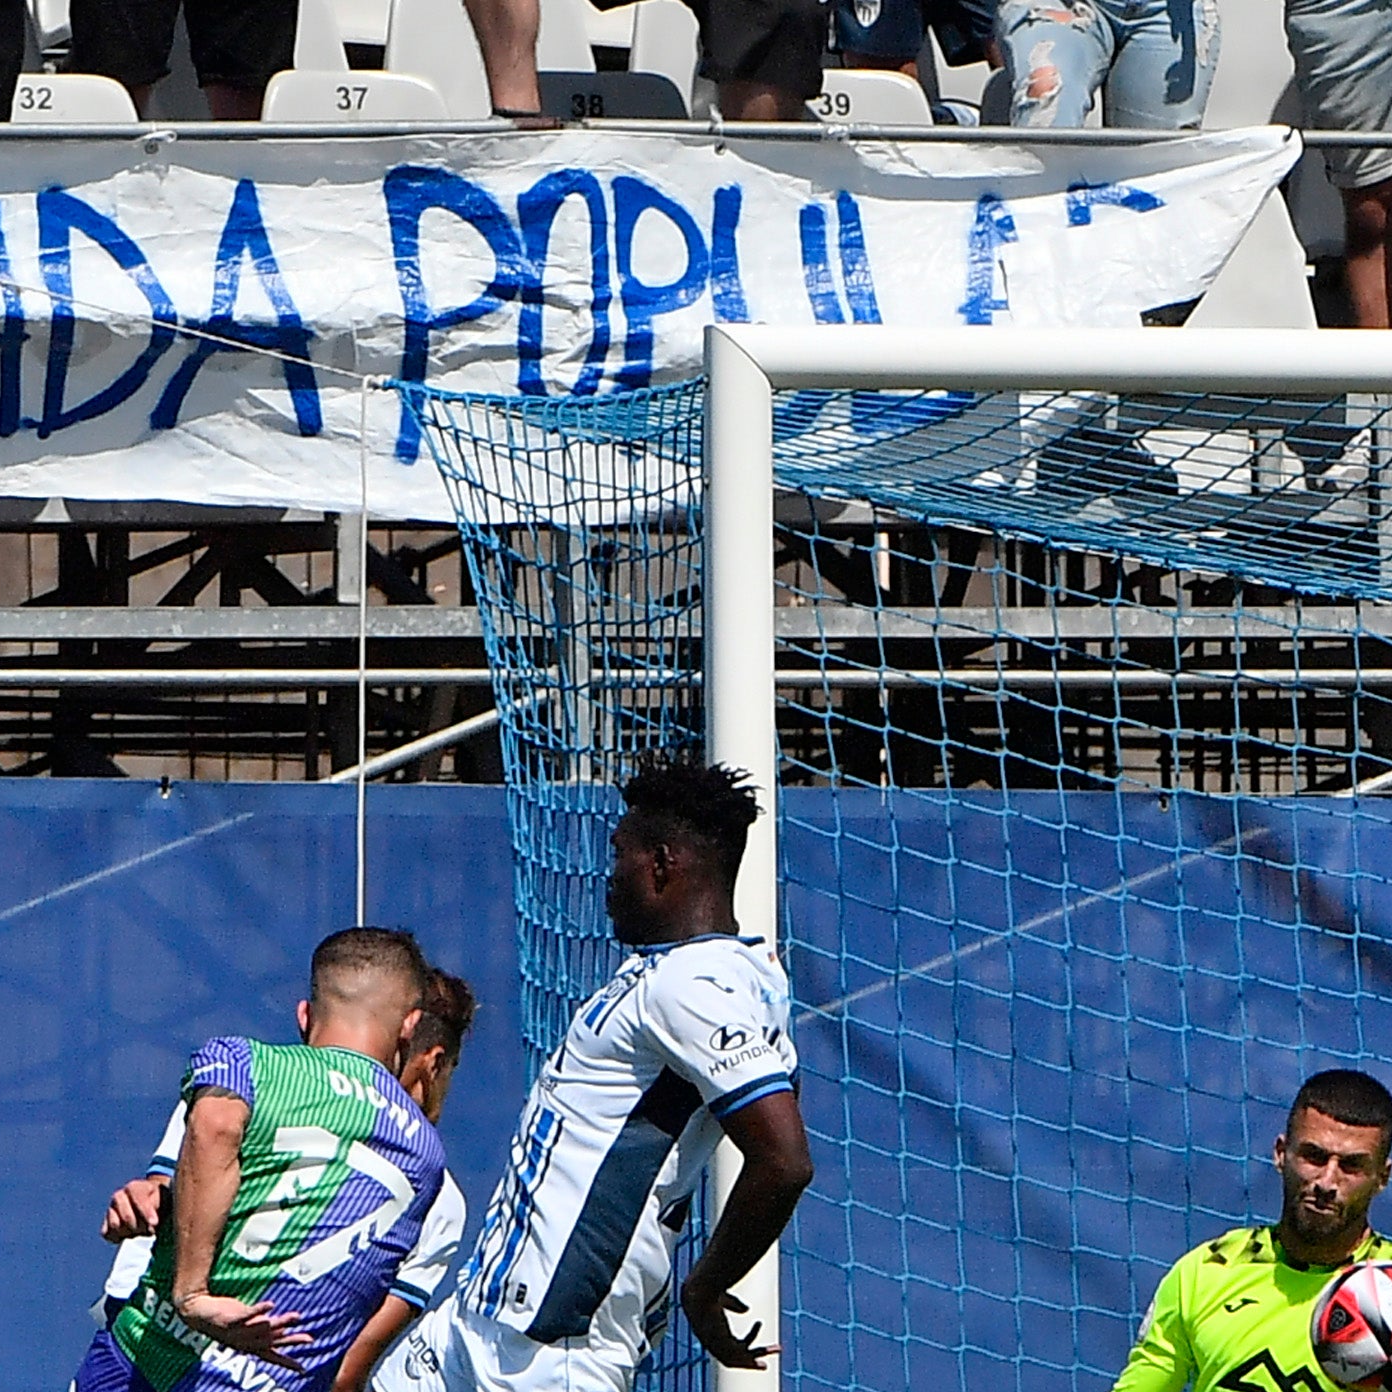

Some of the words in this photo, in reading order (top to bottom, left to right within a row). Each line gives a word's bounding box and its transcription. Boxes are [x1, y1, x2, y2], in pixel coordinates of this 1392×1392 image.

[20, 86, 53, 110] 32
[335, 86, 369, 110] 37
[571, 93, 605, 118] 38
[818, 92, 852, 116] 39
[708, 1044, 774, 1076] HYUNDA
[328, 1070, 421, 1139] DIONI
